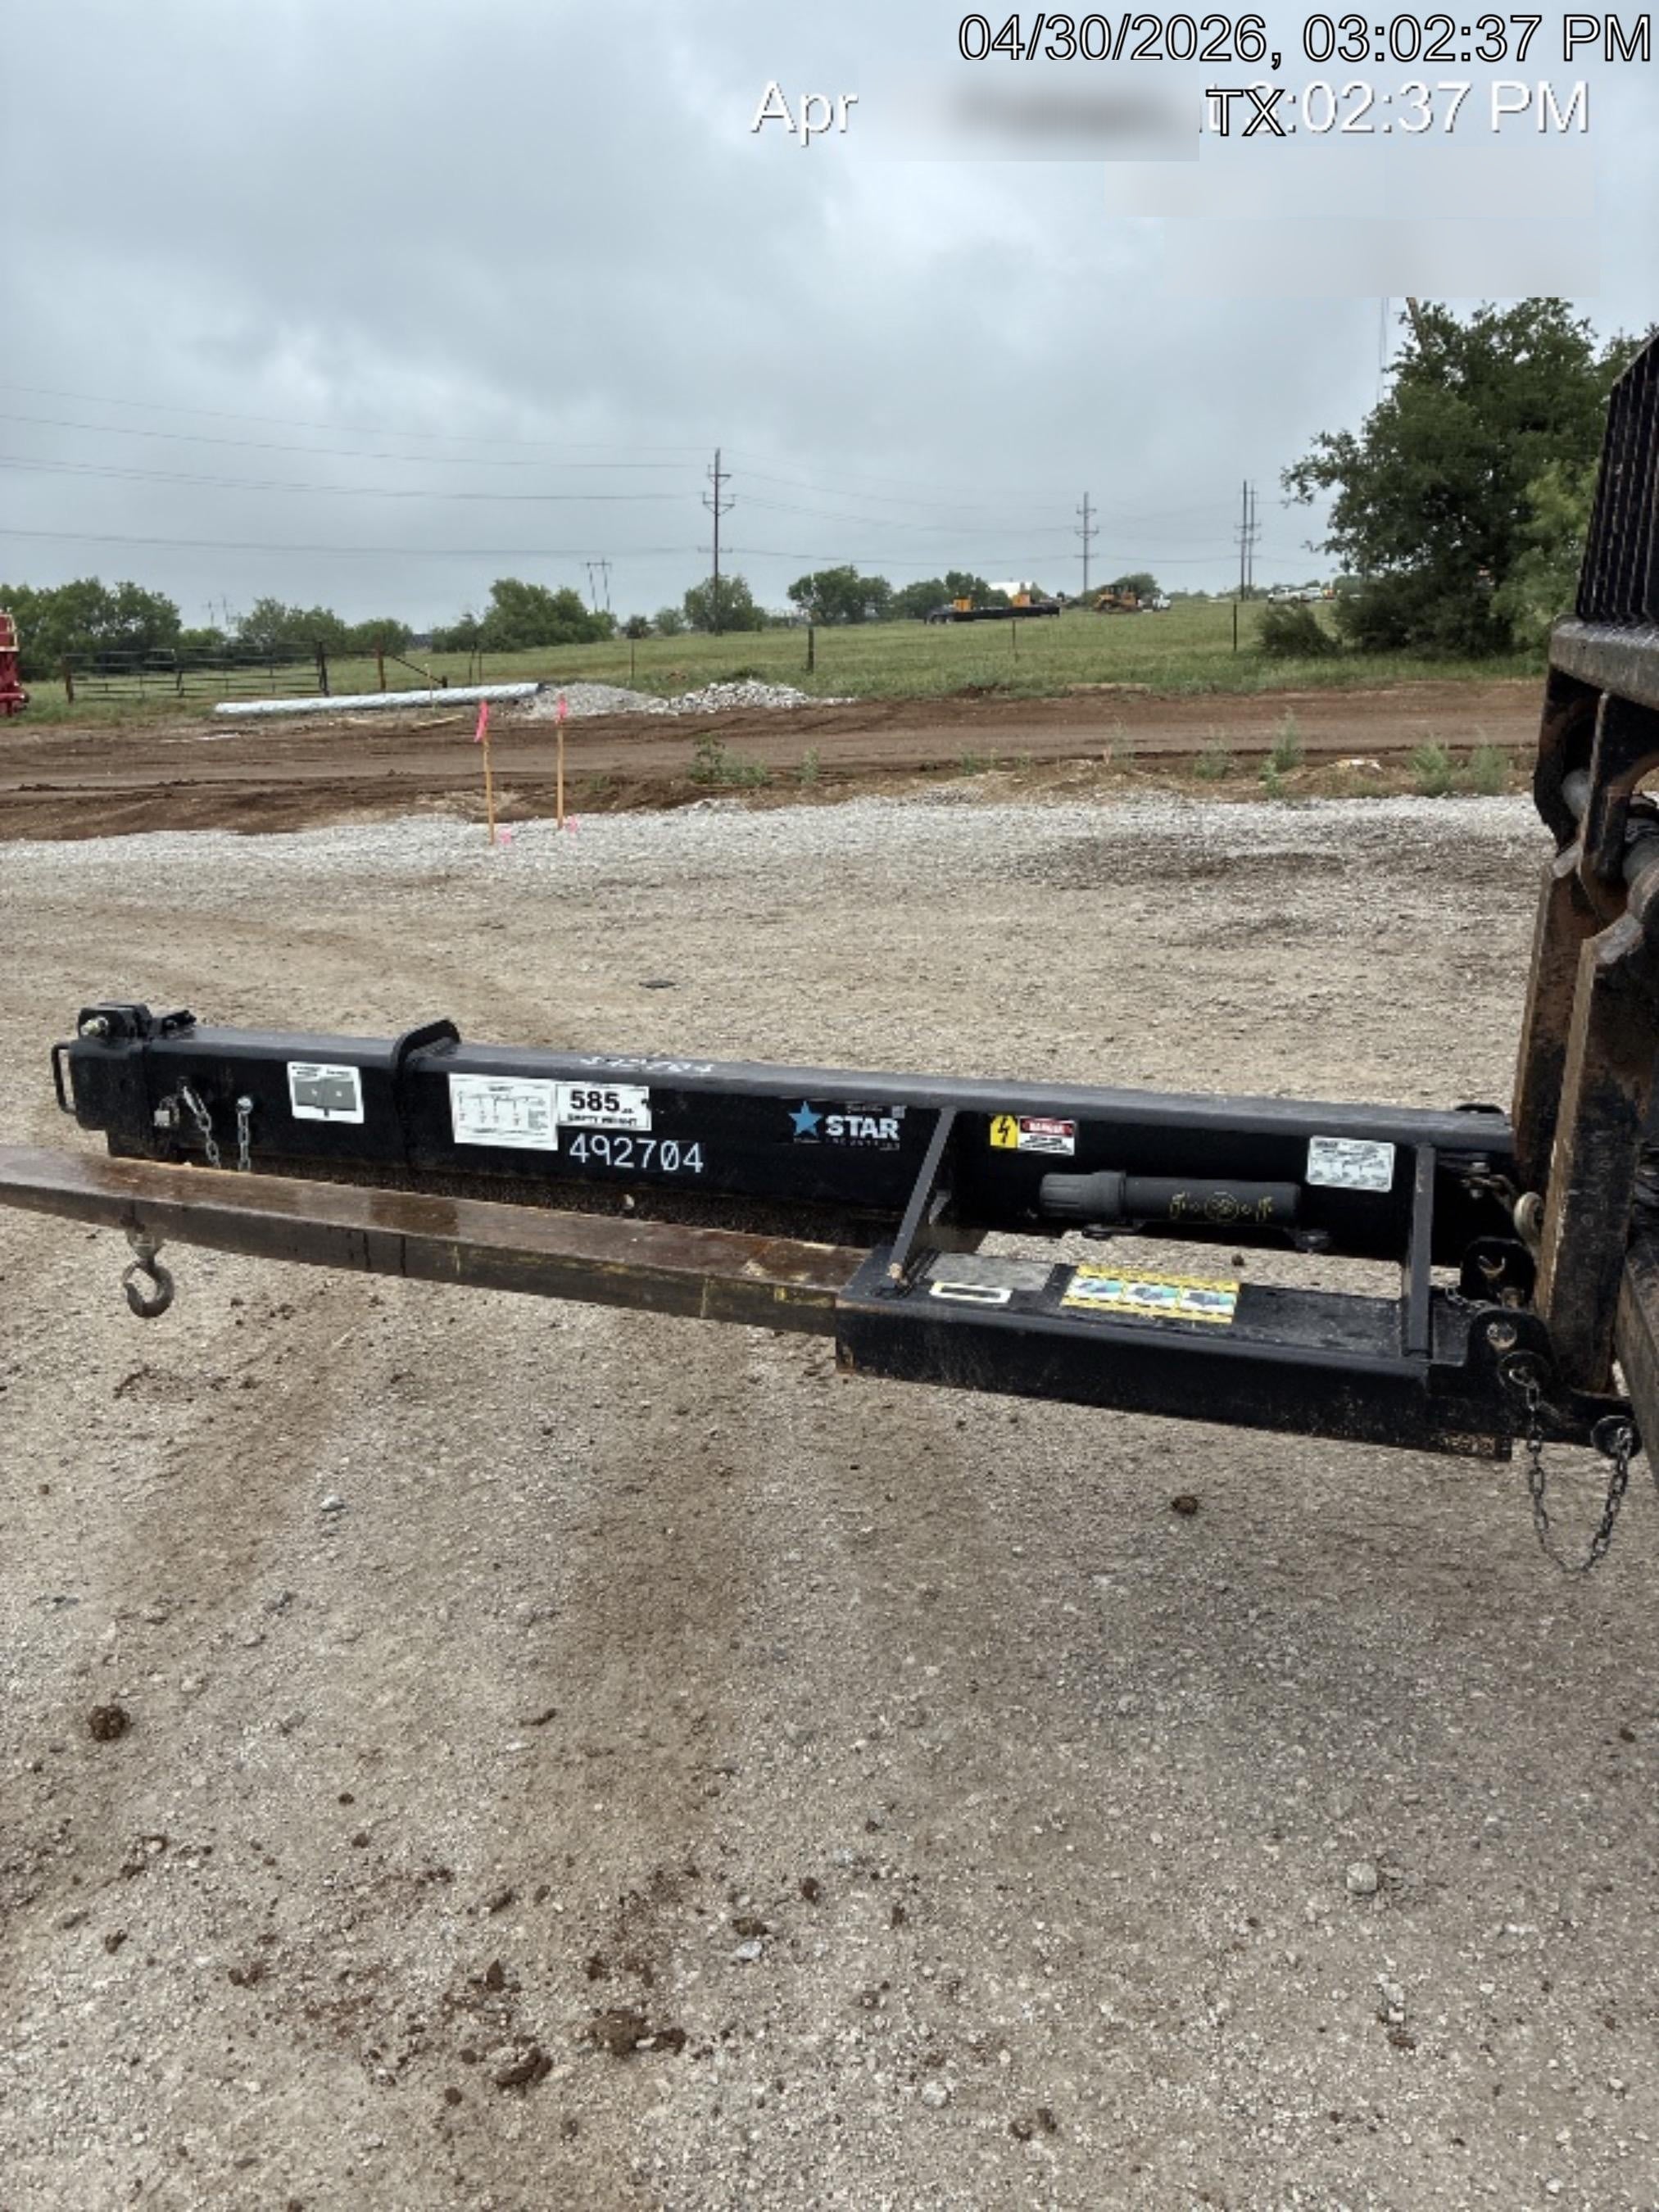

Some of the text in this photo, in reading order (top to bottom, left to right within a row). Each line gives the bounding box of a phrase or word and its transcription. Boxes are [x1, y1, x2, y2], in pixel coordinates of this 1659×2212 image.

[570, 1090, 620, 1112] 585
[825, 1114, 900, 1140] STAR
[569, 1132, 705, 1173] 492704
